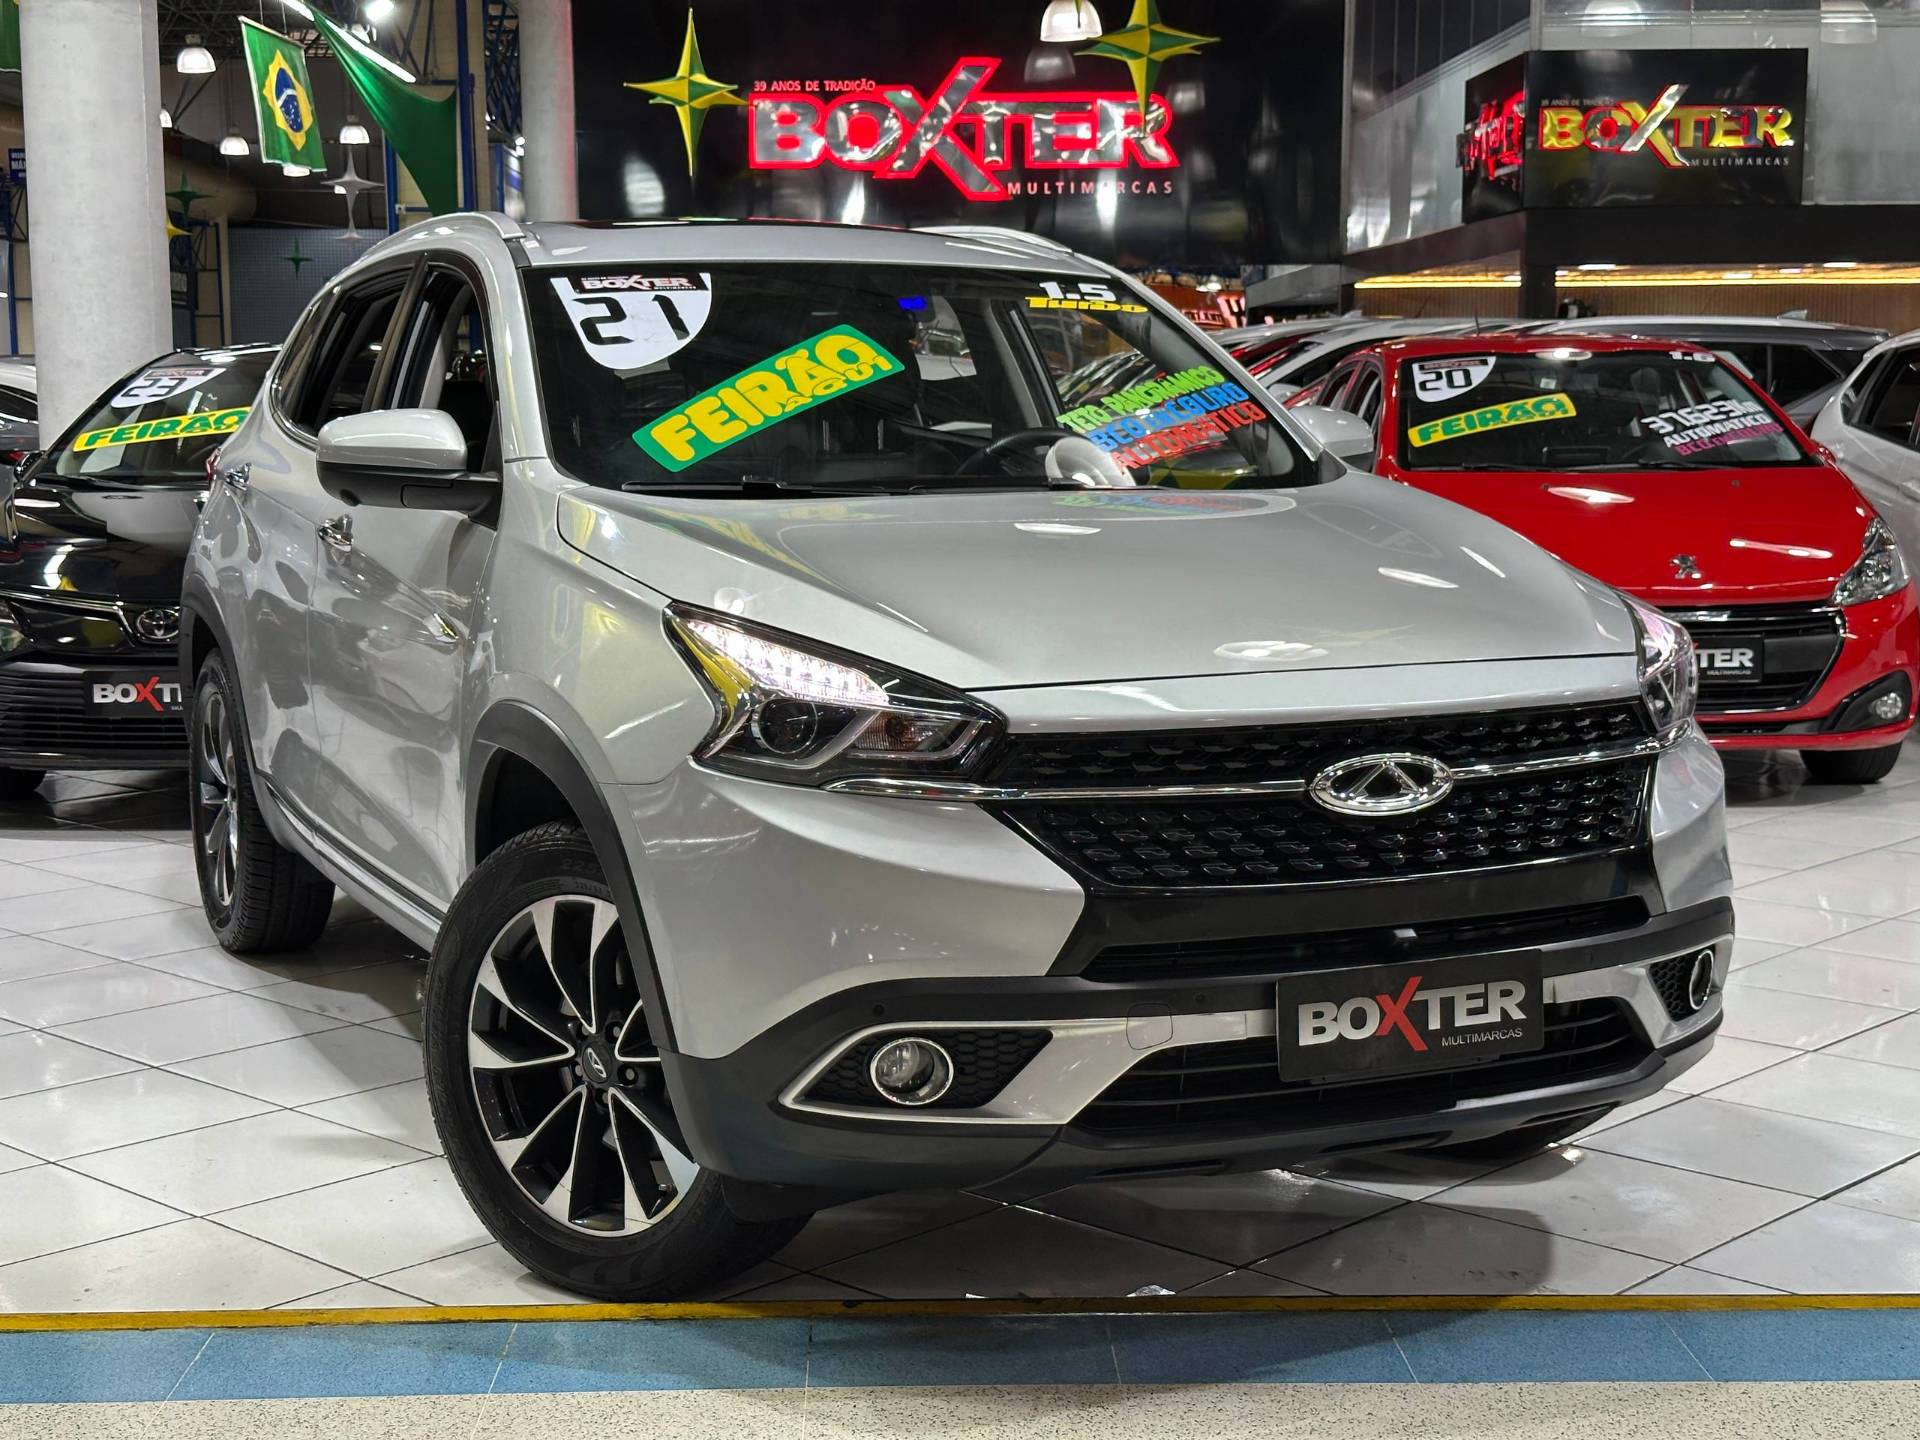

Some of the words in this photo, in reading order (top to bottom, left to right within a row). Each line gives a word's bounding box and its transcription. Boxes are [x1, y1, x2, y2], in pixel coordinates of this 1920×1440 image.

[753, 80, 767, 92] 39
[770, 80, 802, 92] ANOS
[804, 80, 820, 92] DE
[823, 78, 876, 94] TRADIÇÃO
[748, 56, 1180, 201] BOXTER
[1539, 83, 1795, 168] BOXTER
[1691, 157, 1790, 167] MULTIMARCAS
[581, 275, 694, 291] BOXTER
[1039, 281, 1117, 302] 1.5
[572, 294, 691, 346] 21
[120, 377, 188, 398] 23
[1418, 369, 1473, 393] 20
[651, 334, 879, 462] FEIRÃO
[84, 410, 250, 447] FEIRÃO
[1056, 404, 1113, 434] TETO
[1087, 416, 1146, 453] BCO
[1164, 381, 1250, 421] COURO
[1417, 397, 1567, 442] FEIRÃO
[1693, 642, 1754, 668] TER
[1298, 976, 1527, 1052] BOXTER
[1441, 1027, 1524, 1047] MULTIMARCAS
